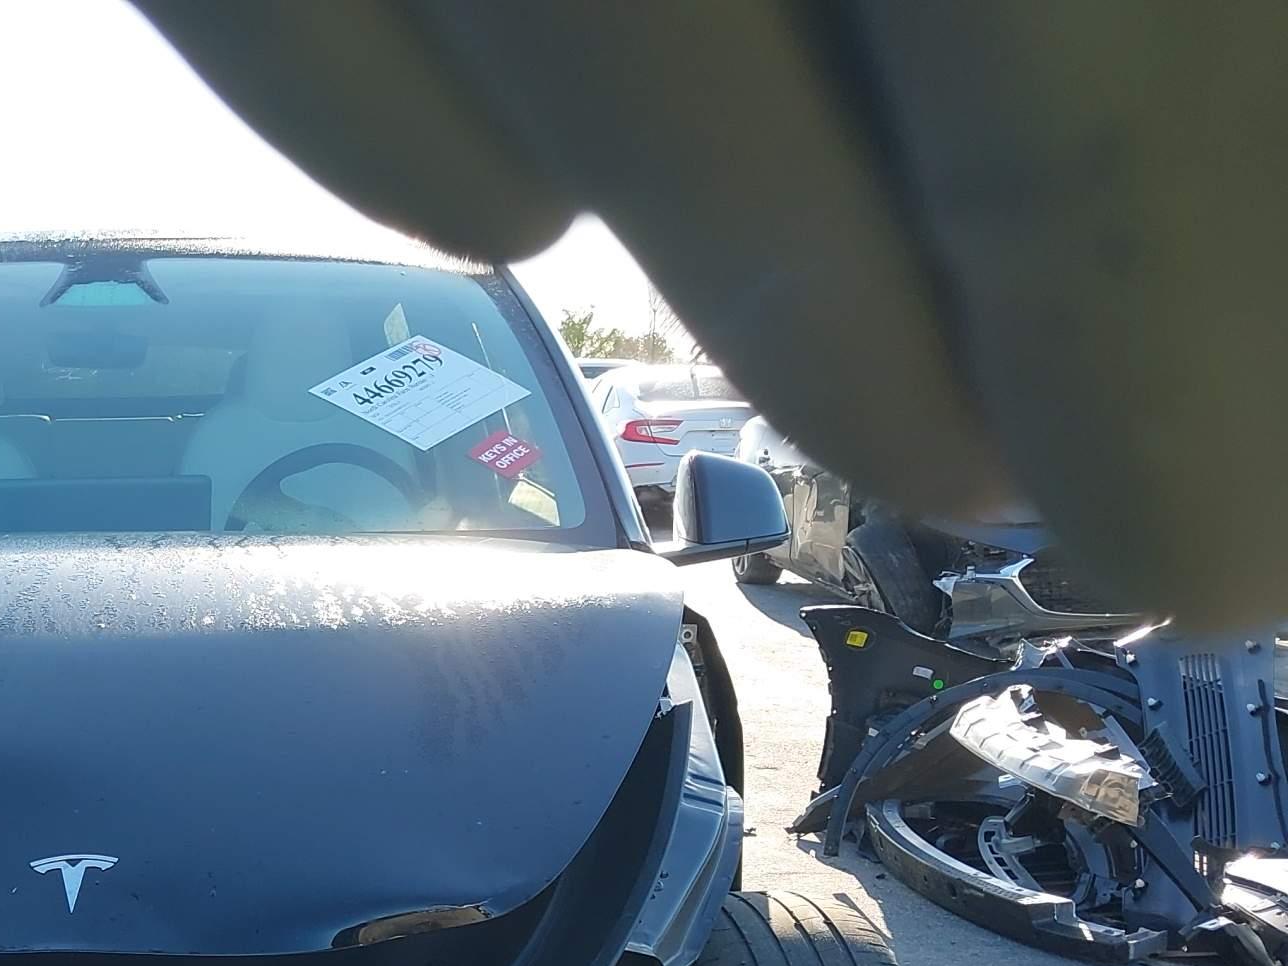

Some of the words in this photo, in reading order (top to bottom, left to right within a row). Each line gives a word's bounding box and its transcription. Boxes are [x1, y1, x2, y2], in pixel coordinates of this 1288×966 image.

[353, 354, 443, 405] 44669279
[478, 443, 508, 463] KEYS
[502, 436, 518, 447] IN
[495, 445, 530, 469] OFFICE
